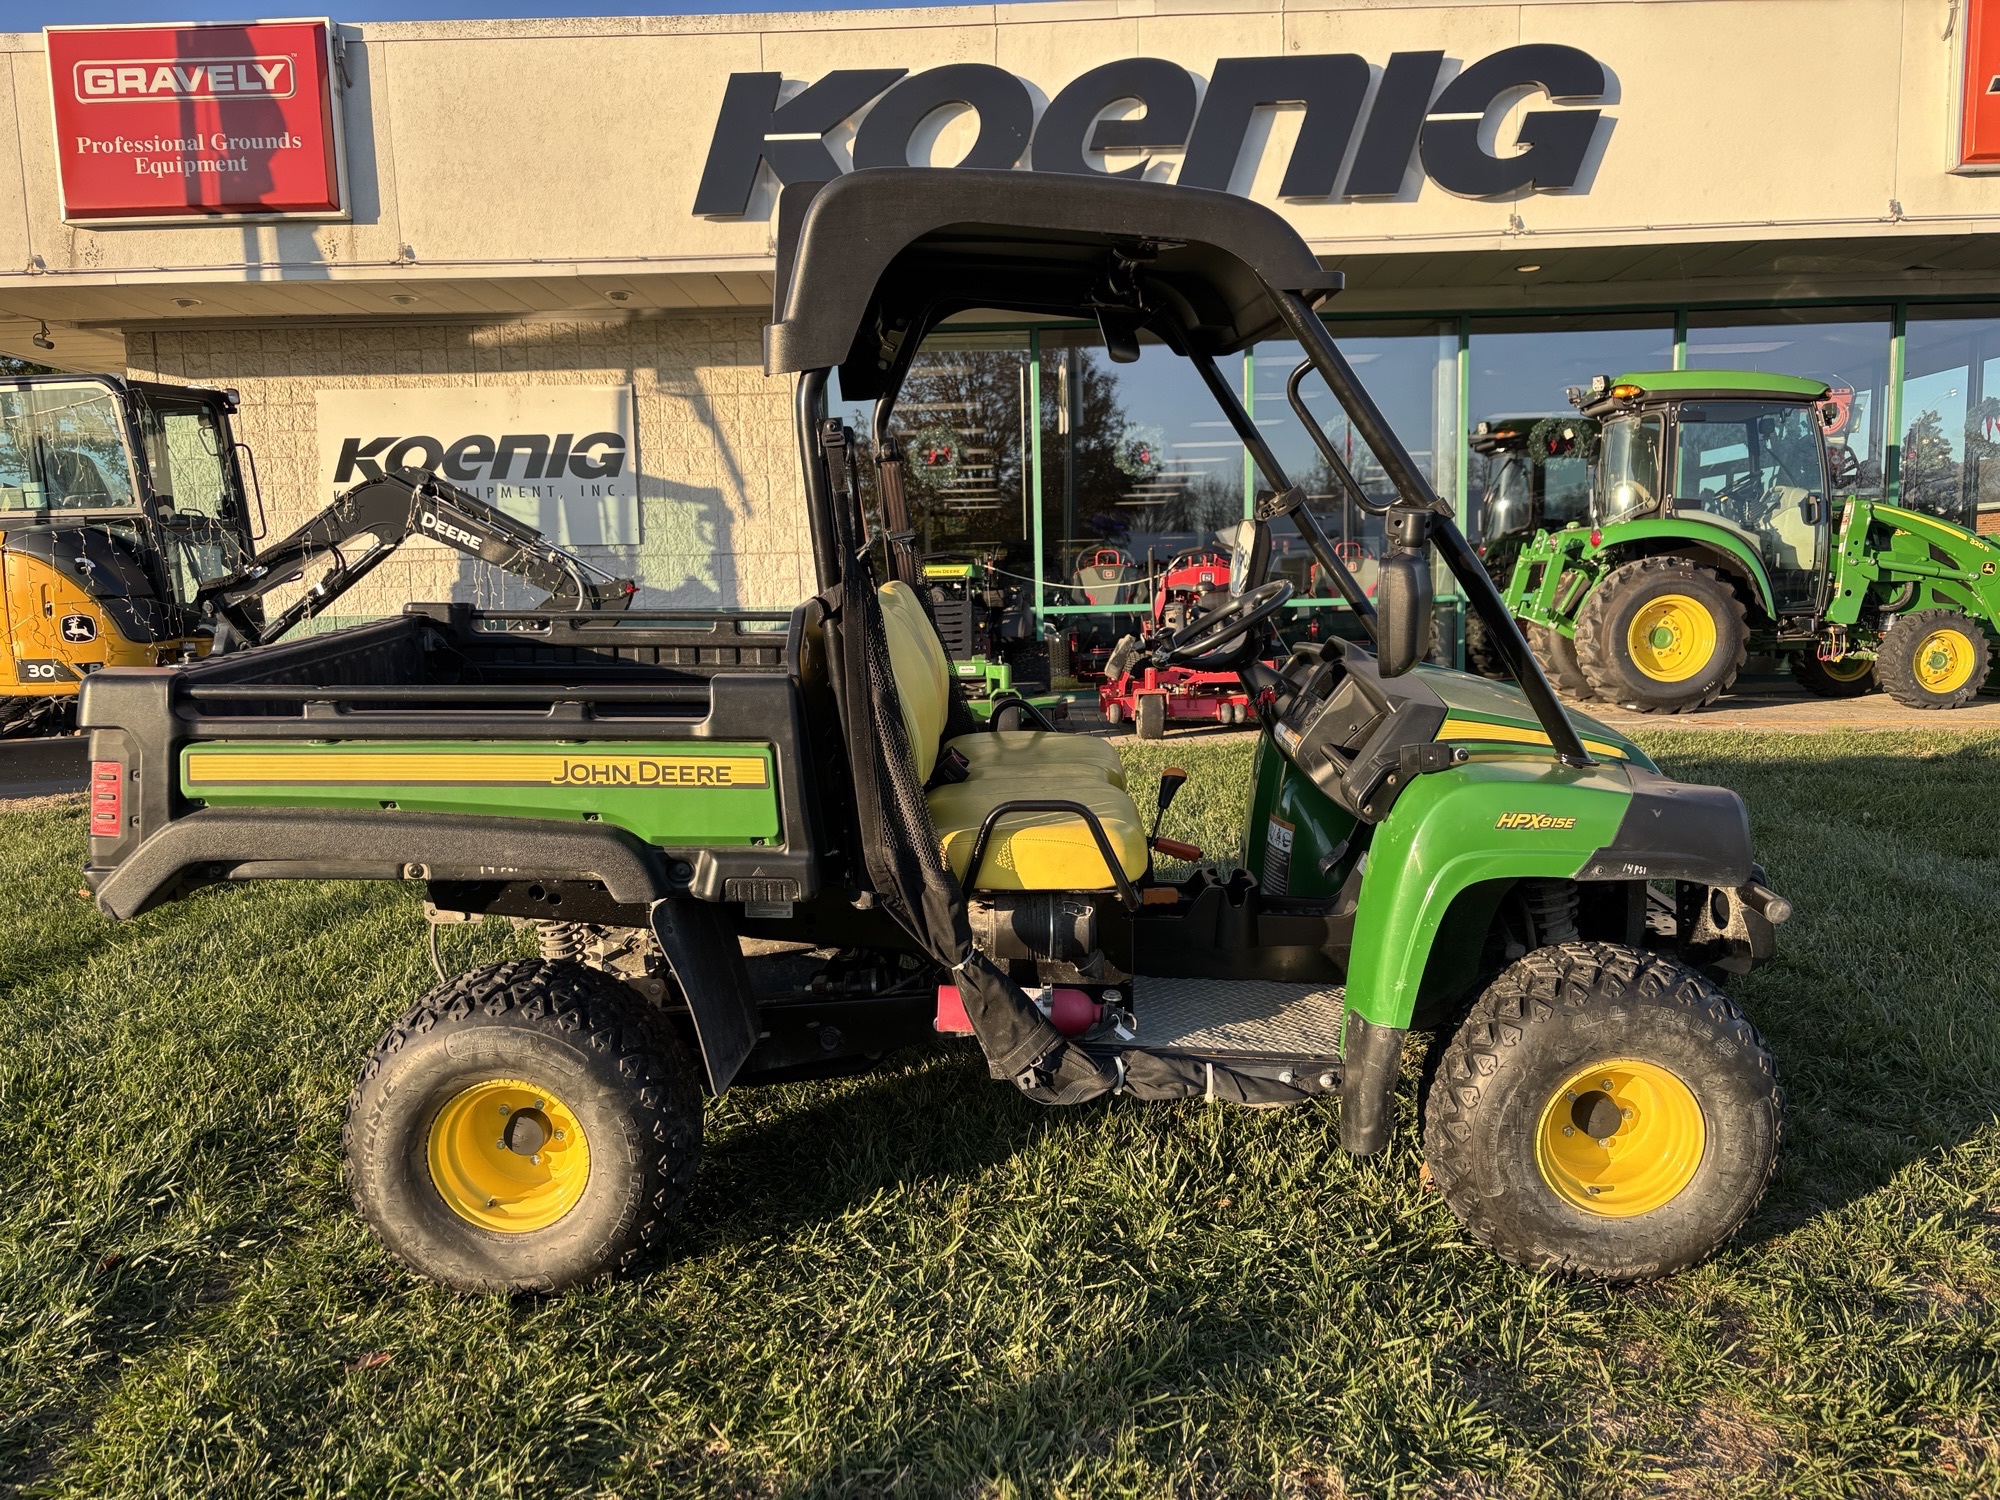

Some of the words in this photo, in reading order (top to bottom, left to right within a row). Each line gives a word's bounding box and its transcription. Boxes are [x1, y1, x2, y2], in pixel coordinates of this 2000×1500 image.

[83, 63, 286, 95] GRAVELY
[76, 133, 205, 154] Professional
[210, 131, 302, 152] Grounds
[134, 154, 249, 179] Equipment
[580, 484, 626, 498] INC.
[420, 511, 483, 550] DEERE
[553, 759, 631, 782] JOHN
[638, 760, 732, 783] DEERE
[1496, 813, 1577, 830] HPX815E
[1571, 1005, 1627, 1031] ALL
[1639, 1004, 1714, 1040] TRAIL
[1716, 1035, 1739, 1057] II
[362, 1077, 398, 1199] CARLISLE
[616, 1114, 644, 1164] ALL
[609, 1172, 645, 1240] TRAIL
